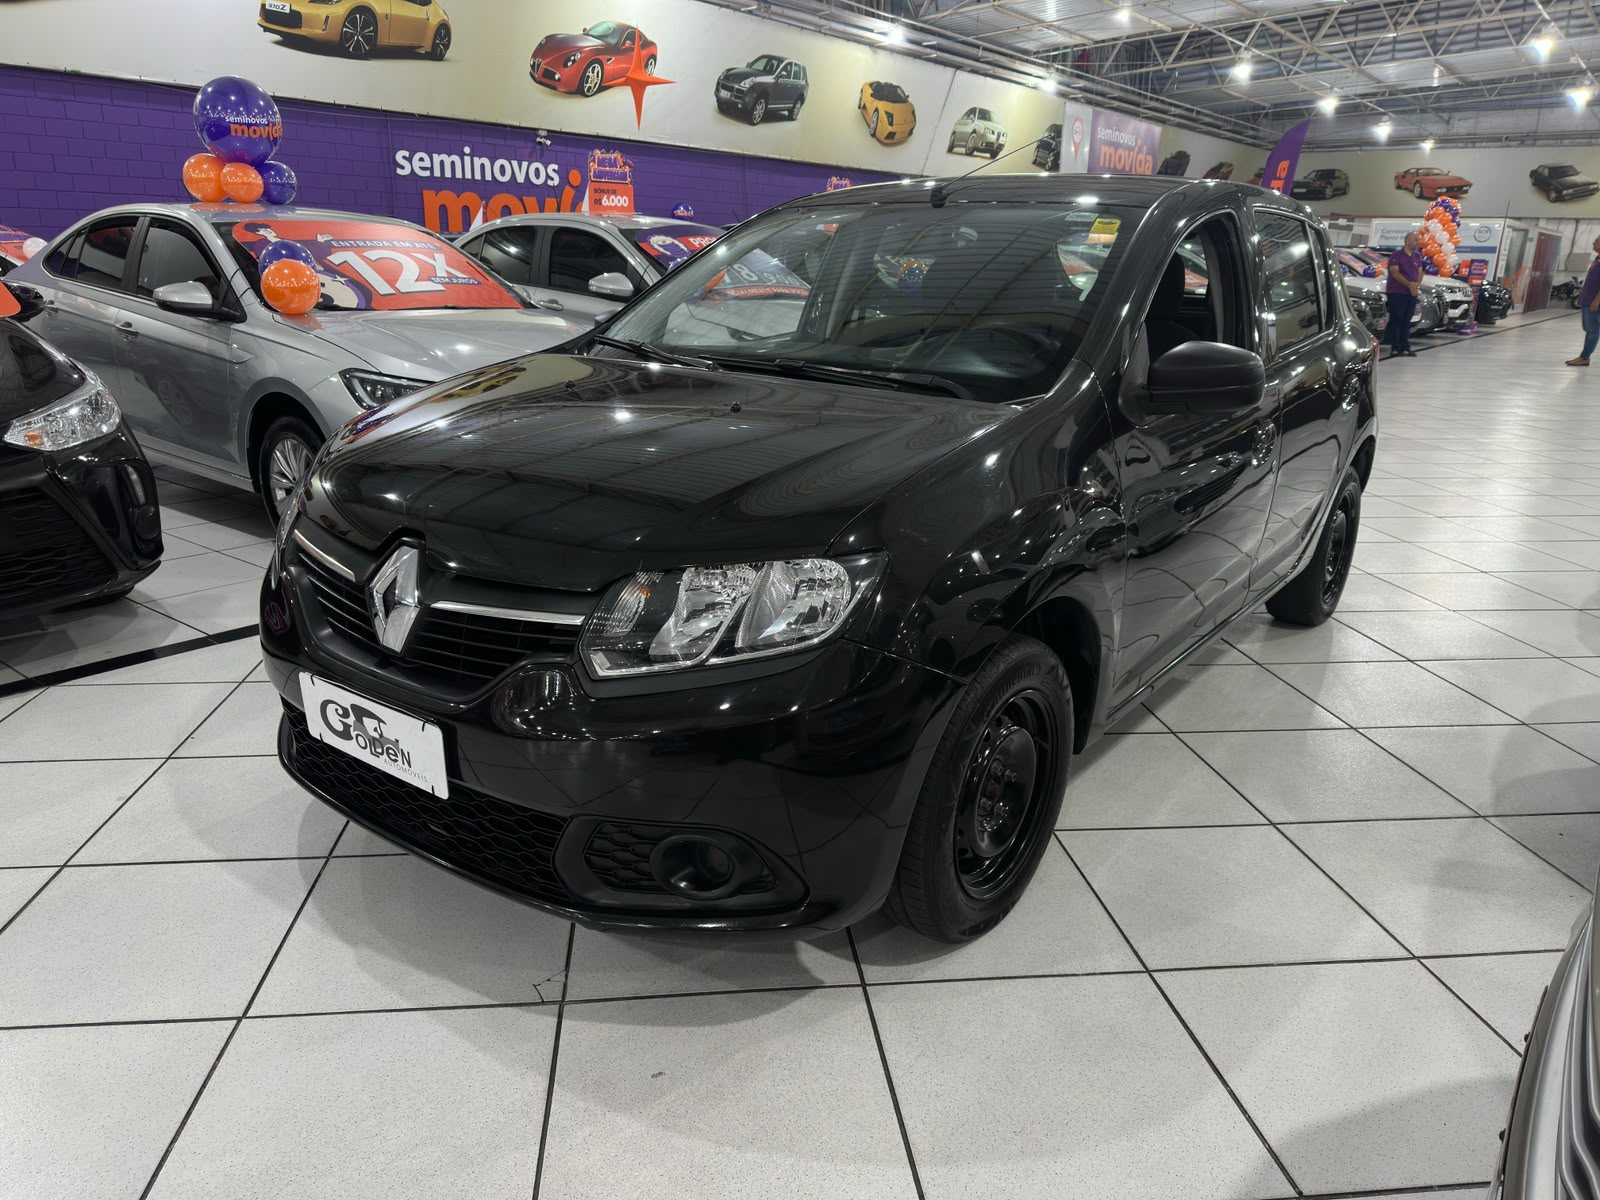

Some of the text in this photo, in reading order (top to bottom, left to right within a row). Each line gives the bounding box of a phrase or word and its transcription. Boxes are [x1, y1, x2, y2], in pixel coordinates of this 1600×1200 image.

[225, 115, 268, 124] seminovos
[1097, 126, 1136, 146] seminovos
[395, 146, 560, 186] seminovos
[1100, 138, 1153, 175] movida
[422, 169, 585, 232] movi
[331, 240, 393, 248] ENTRADA
[688, 237, 717, 248] PRO
[326, 250, 469, 295] 12X
